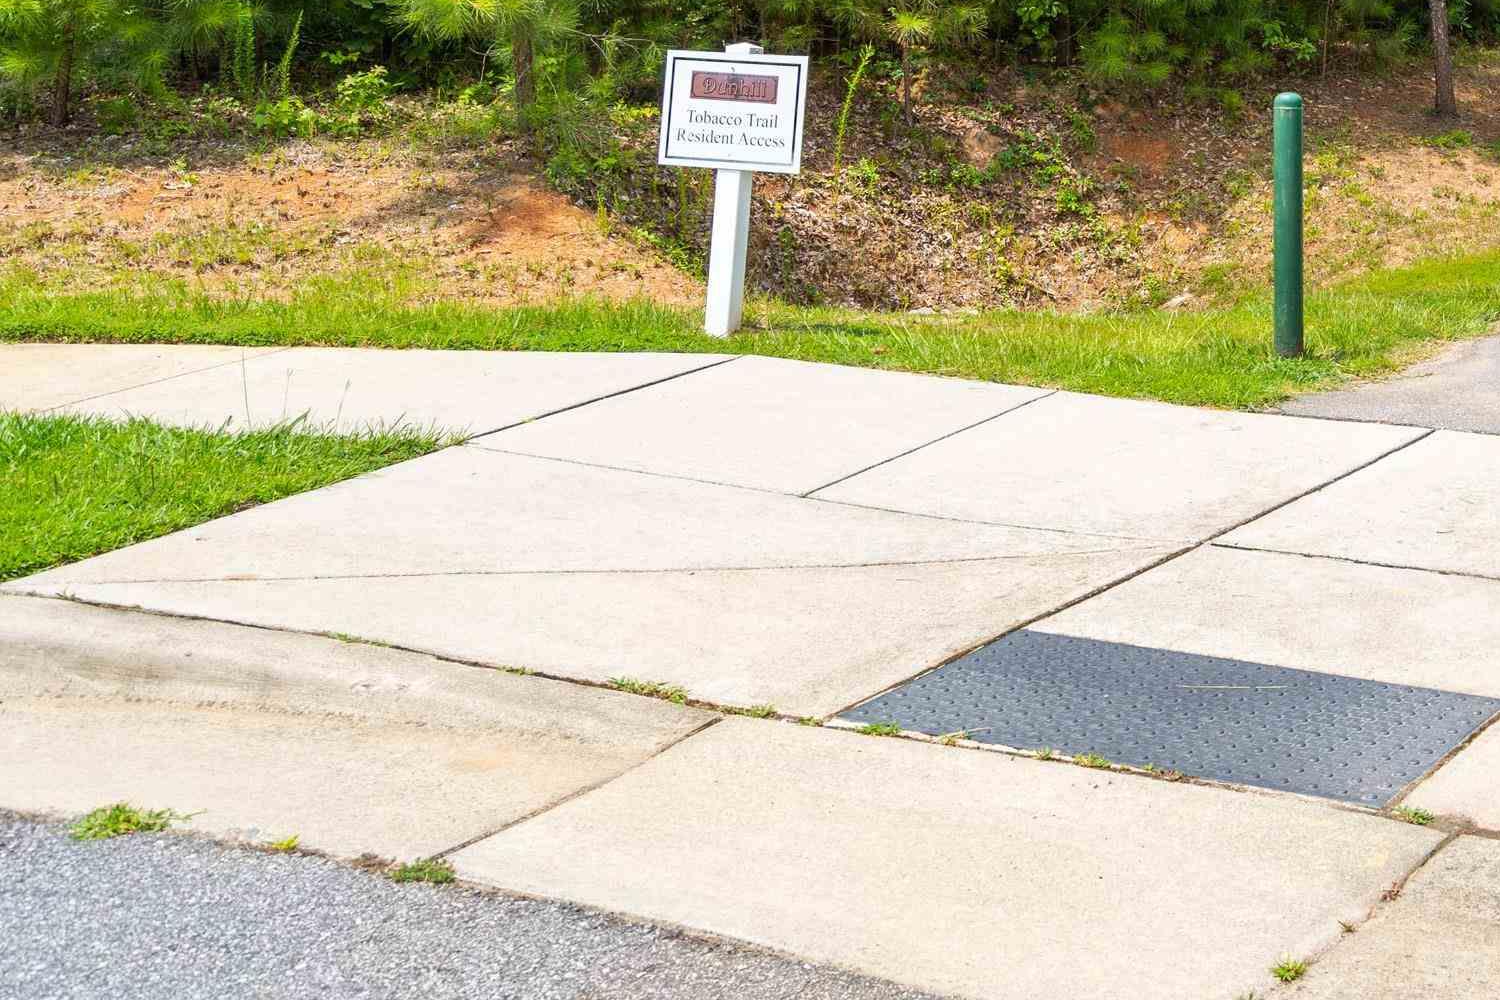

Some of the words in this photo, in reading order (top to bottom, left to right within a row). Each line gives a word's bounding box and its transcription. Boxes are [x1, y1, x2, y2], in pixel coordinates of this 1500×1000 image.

[687, 109, 743, 127] Tobacco
[746, 113, 779, 129] Trail
[676, 128, 734, 145] Resident
[739, 132, 786, 148] Access
